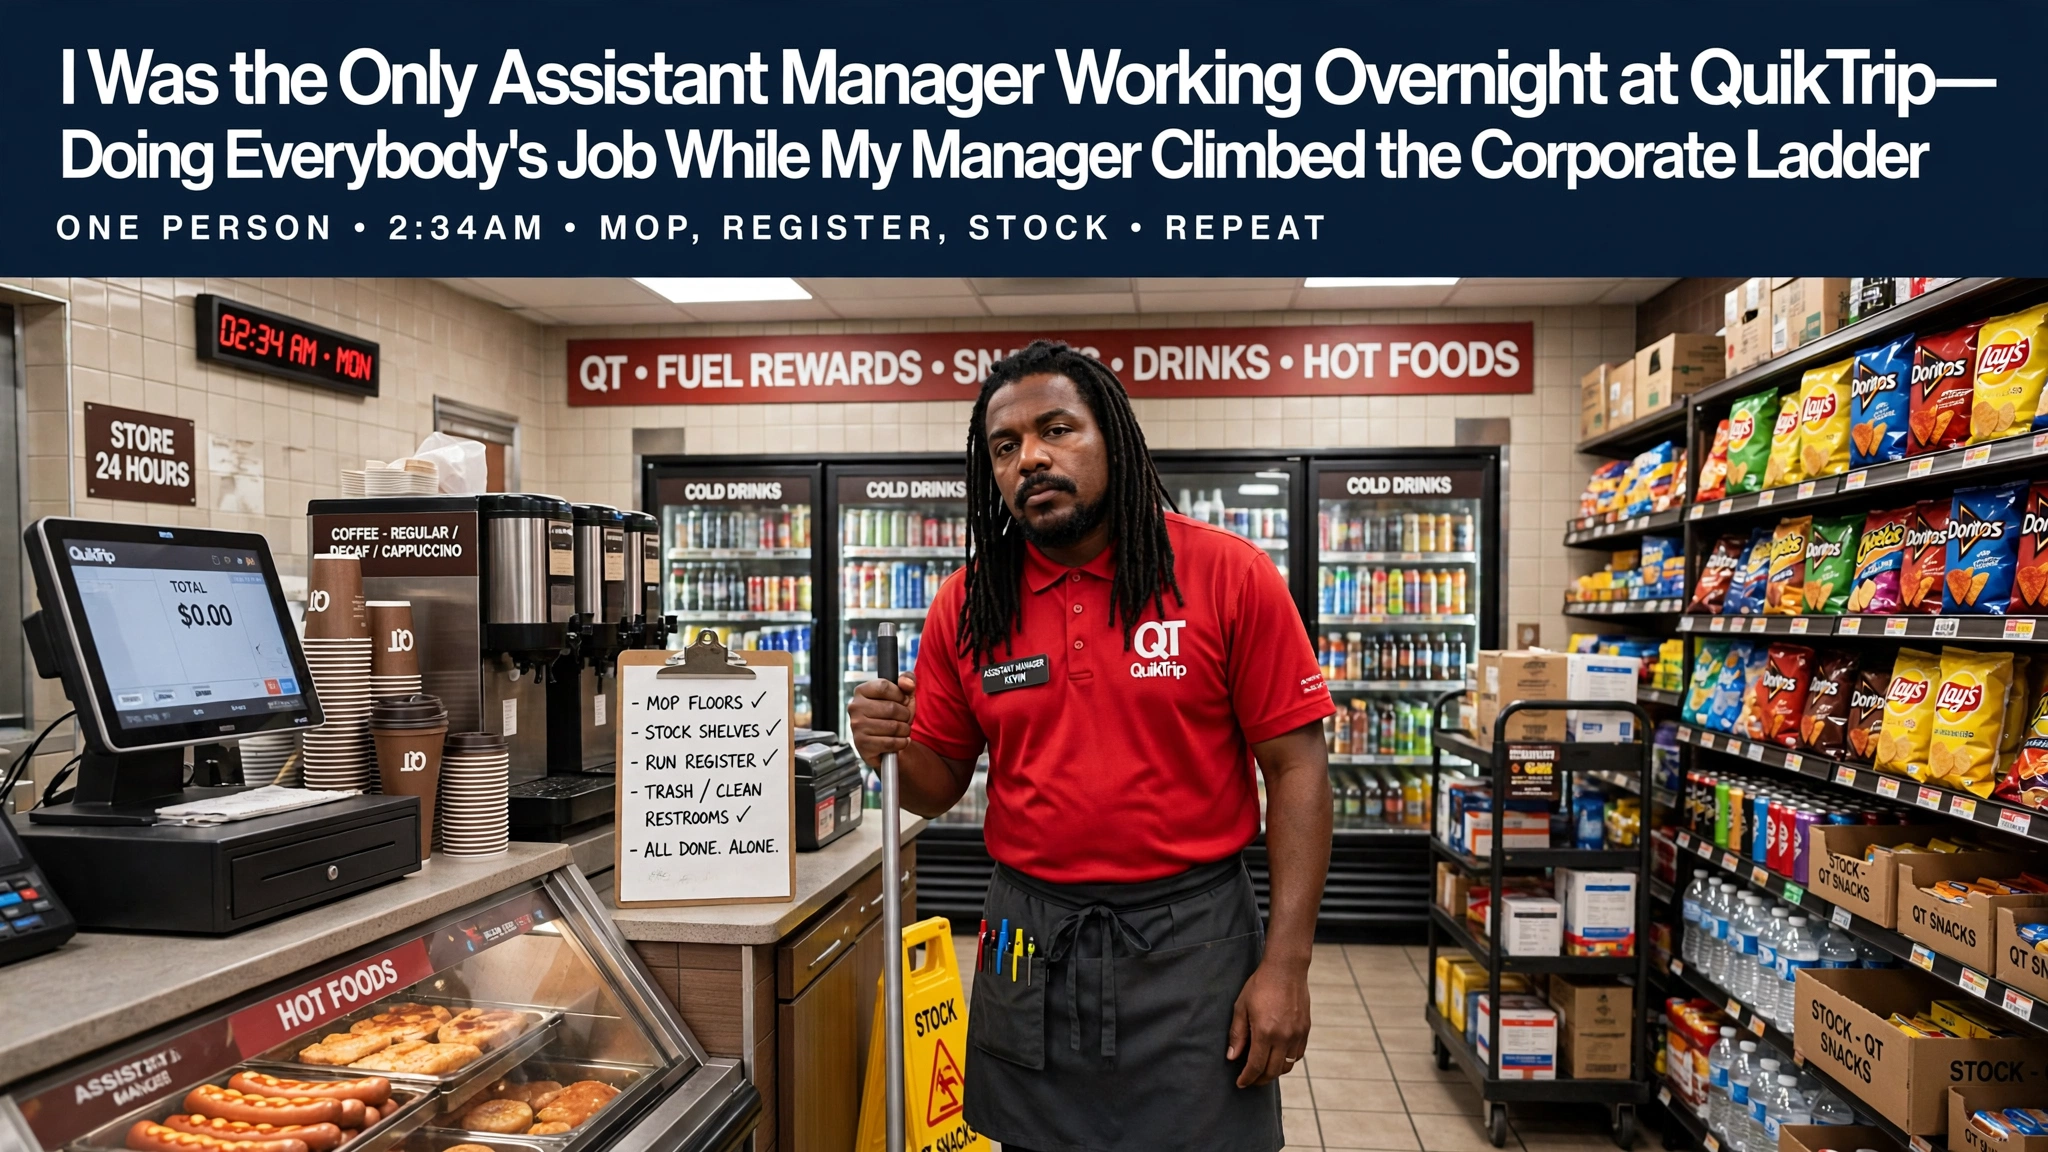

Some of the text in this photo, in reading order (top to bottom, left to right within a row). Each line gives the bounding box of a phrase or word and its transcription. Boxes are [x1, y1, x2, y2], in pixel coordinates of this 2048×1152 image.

[220, 314, 372, 381] 02:34 AM MON
[579, 355, 628, 393] QT
[657, 353, 743, 389] FUEL
[750, 349, 922, 388] REWARDS
[1133, 343, 1270, 381] DRINKS
[1304, 342, 1381, 379] HOT
[1389, 340, 1520, 378] FOODS
[1911, 358, 1967, 385] Doritos
[1851, 373, 1897, 398] Doritos
[111, 421, 174, 455] STORE
[95, 452, 190, 488] 24 HOURS
[685, 482, 782, 500] COLD DRINKS
[866, 481, 967, 498] COLD DRINKS
[1347, 475, 1452, 495] COLD DRINKS
[331, 527, 379, 541] COFFEE
[391, 526, 449, 540] REGULAR
[1948, 520, 2004, 539] Doritos
[330, 545, 370, 558] DECAF
[381, 544, 462, 558] CAPPUCCINO
[169, 580, 207, 594] TOTAL
[177, 602, 233, 629] $0.00
[1134, 620, 1186, 660] QT
[1130, 661, 1187, 680] QuikTrip
[646, 695, 680, 711] MOP
[688, 695, 743, 710] FLOORS
[1937, 683, 1980, 713] Lay's
[645, 724, 691, 740] STOCK
[699, 723, 760, 739] SHELVES
[645, 754, 676, 771] RUN
[685, 753, 756, 769] REGISTER
[644, 784, 694, 799] TRASH
[716, 782, 762, 798] CLEAN
[645, 810, 729, 827] RESTROOMS
[644, 841, 672, 858] ALL
[679, 841, 721, 856] DONE.
[729, 838, 779, 855] ALONE.
[1829, 853, 1860, 879] STOCK
[1818, 868, 1870, 903] QT SNACKS
[1912, 905, 1976, 947] QT SNACKS
[2009, 945, 2028, 969] QT
[276, 959, 398, 1032] HOT FOODS
[914, 998, 958, 1038] STOCK
[1812, 999, 1852, 1043] STOCK
[1865, 1033, 1884, 1062] QT
[1821, 1031, 1871, 1084] SNACKS
[1950, 1060, 2025, 1082] STOCK
